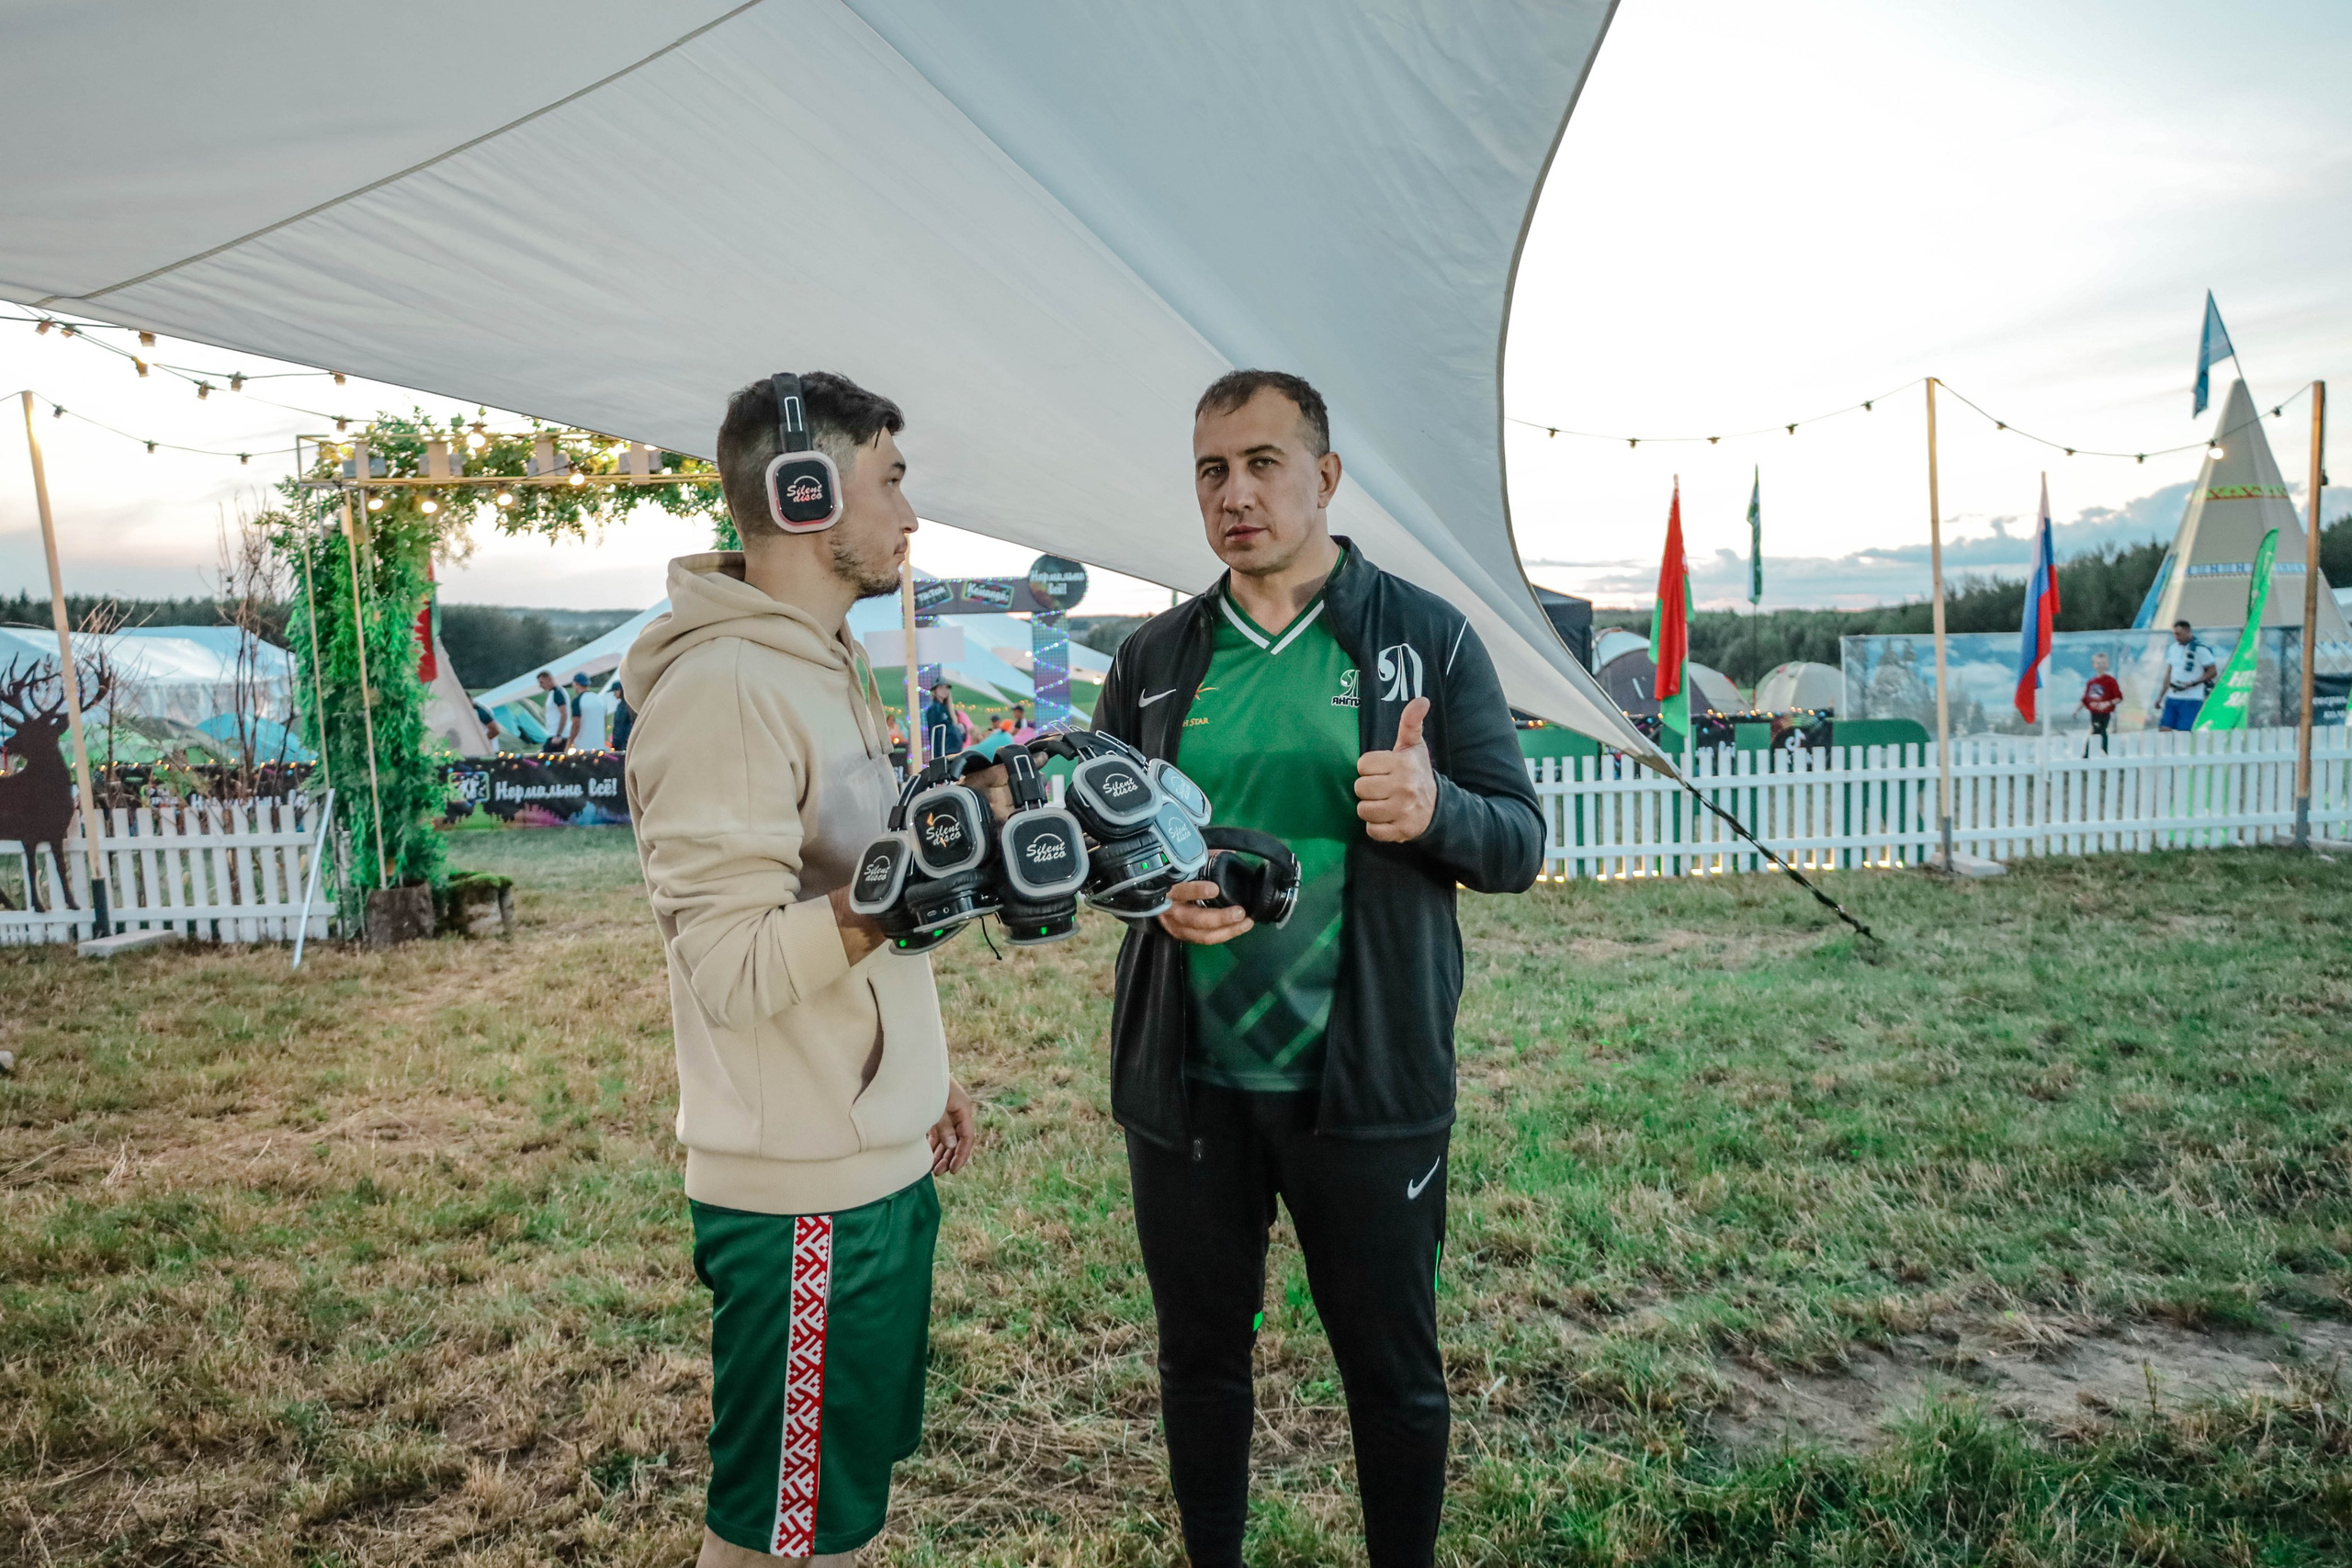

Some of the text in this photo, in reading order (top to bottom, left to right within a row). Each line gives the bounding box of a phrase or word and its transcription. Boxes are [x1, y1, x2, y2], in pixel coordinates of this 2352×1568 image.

[786, 483, 823, 497] Silent
[793, 491, 823, 502] disco
[494, 781, 583, 804] Нормально
[588, 777, 617, 797] всё!
[1102, 777, 1134, 794] Silent
[1113, 784, 1138, 796] disco
[925, 822, 960, 840] Silent
[1168, 823, 1188, 839] Silent
[1176, 829, 1191, 842] disco
[1026, 840, 1066, 857] Silent
[1034, 850, 1067, 863] disco
[864, 863, 891, 876] Silent
[865, 874, 888, 882] disco
